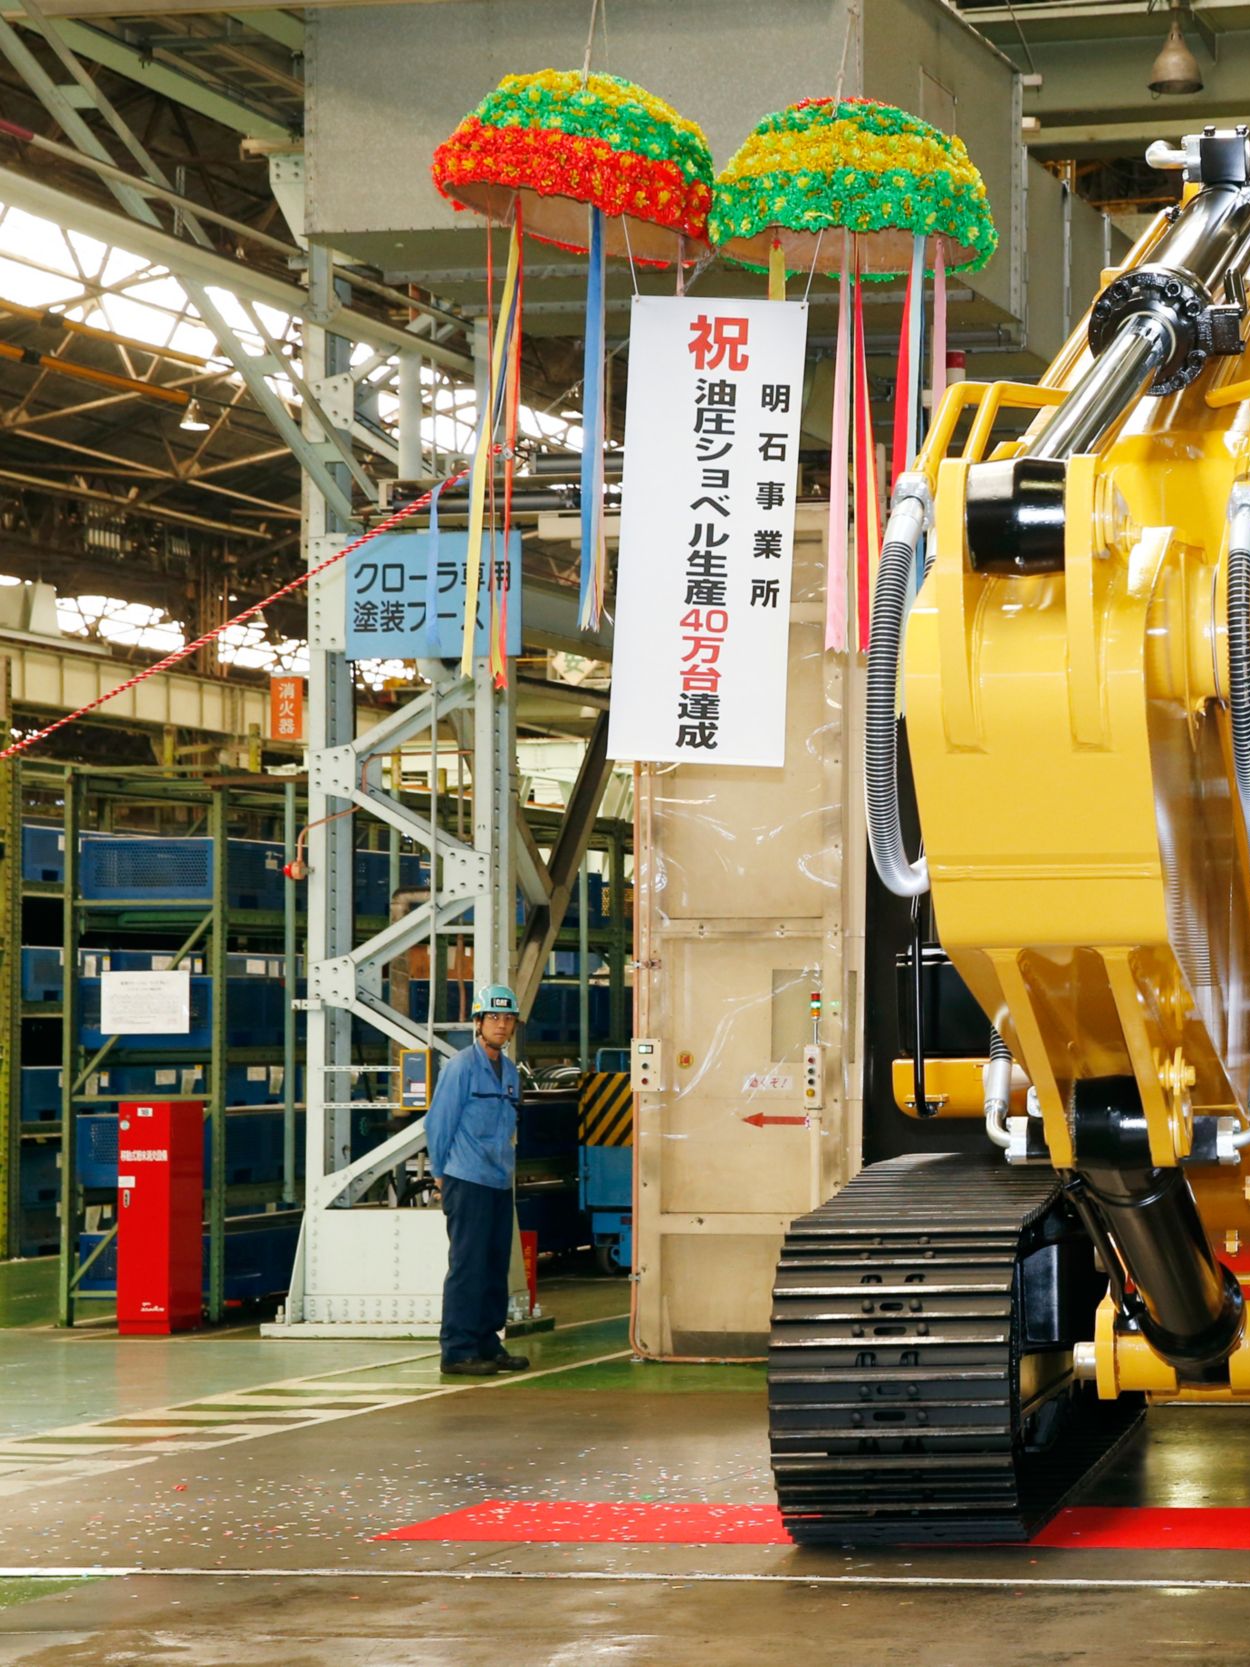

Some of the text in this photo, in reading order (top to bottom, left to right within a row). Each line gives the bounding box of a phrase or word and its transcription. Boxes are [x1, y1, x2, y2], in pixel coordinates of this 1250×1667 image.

[688, 315, 750, 372] 祝
[675, 378, 737, 750] 油圧ショベル生産40万台達成
[750, 384, 791, 608] 明石事業所
[278, 682, 295, 734] 消火器
